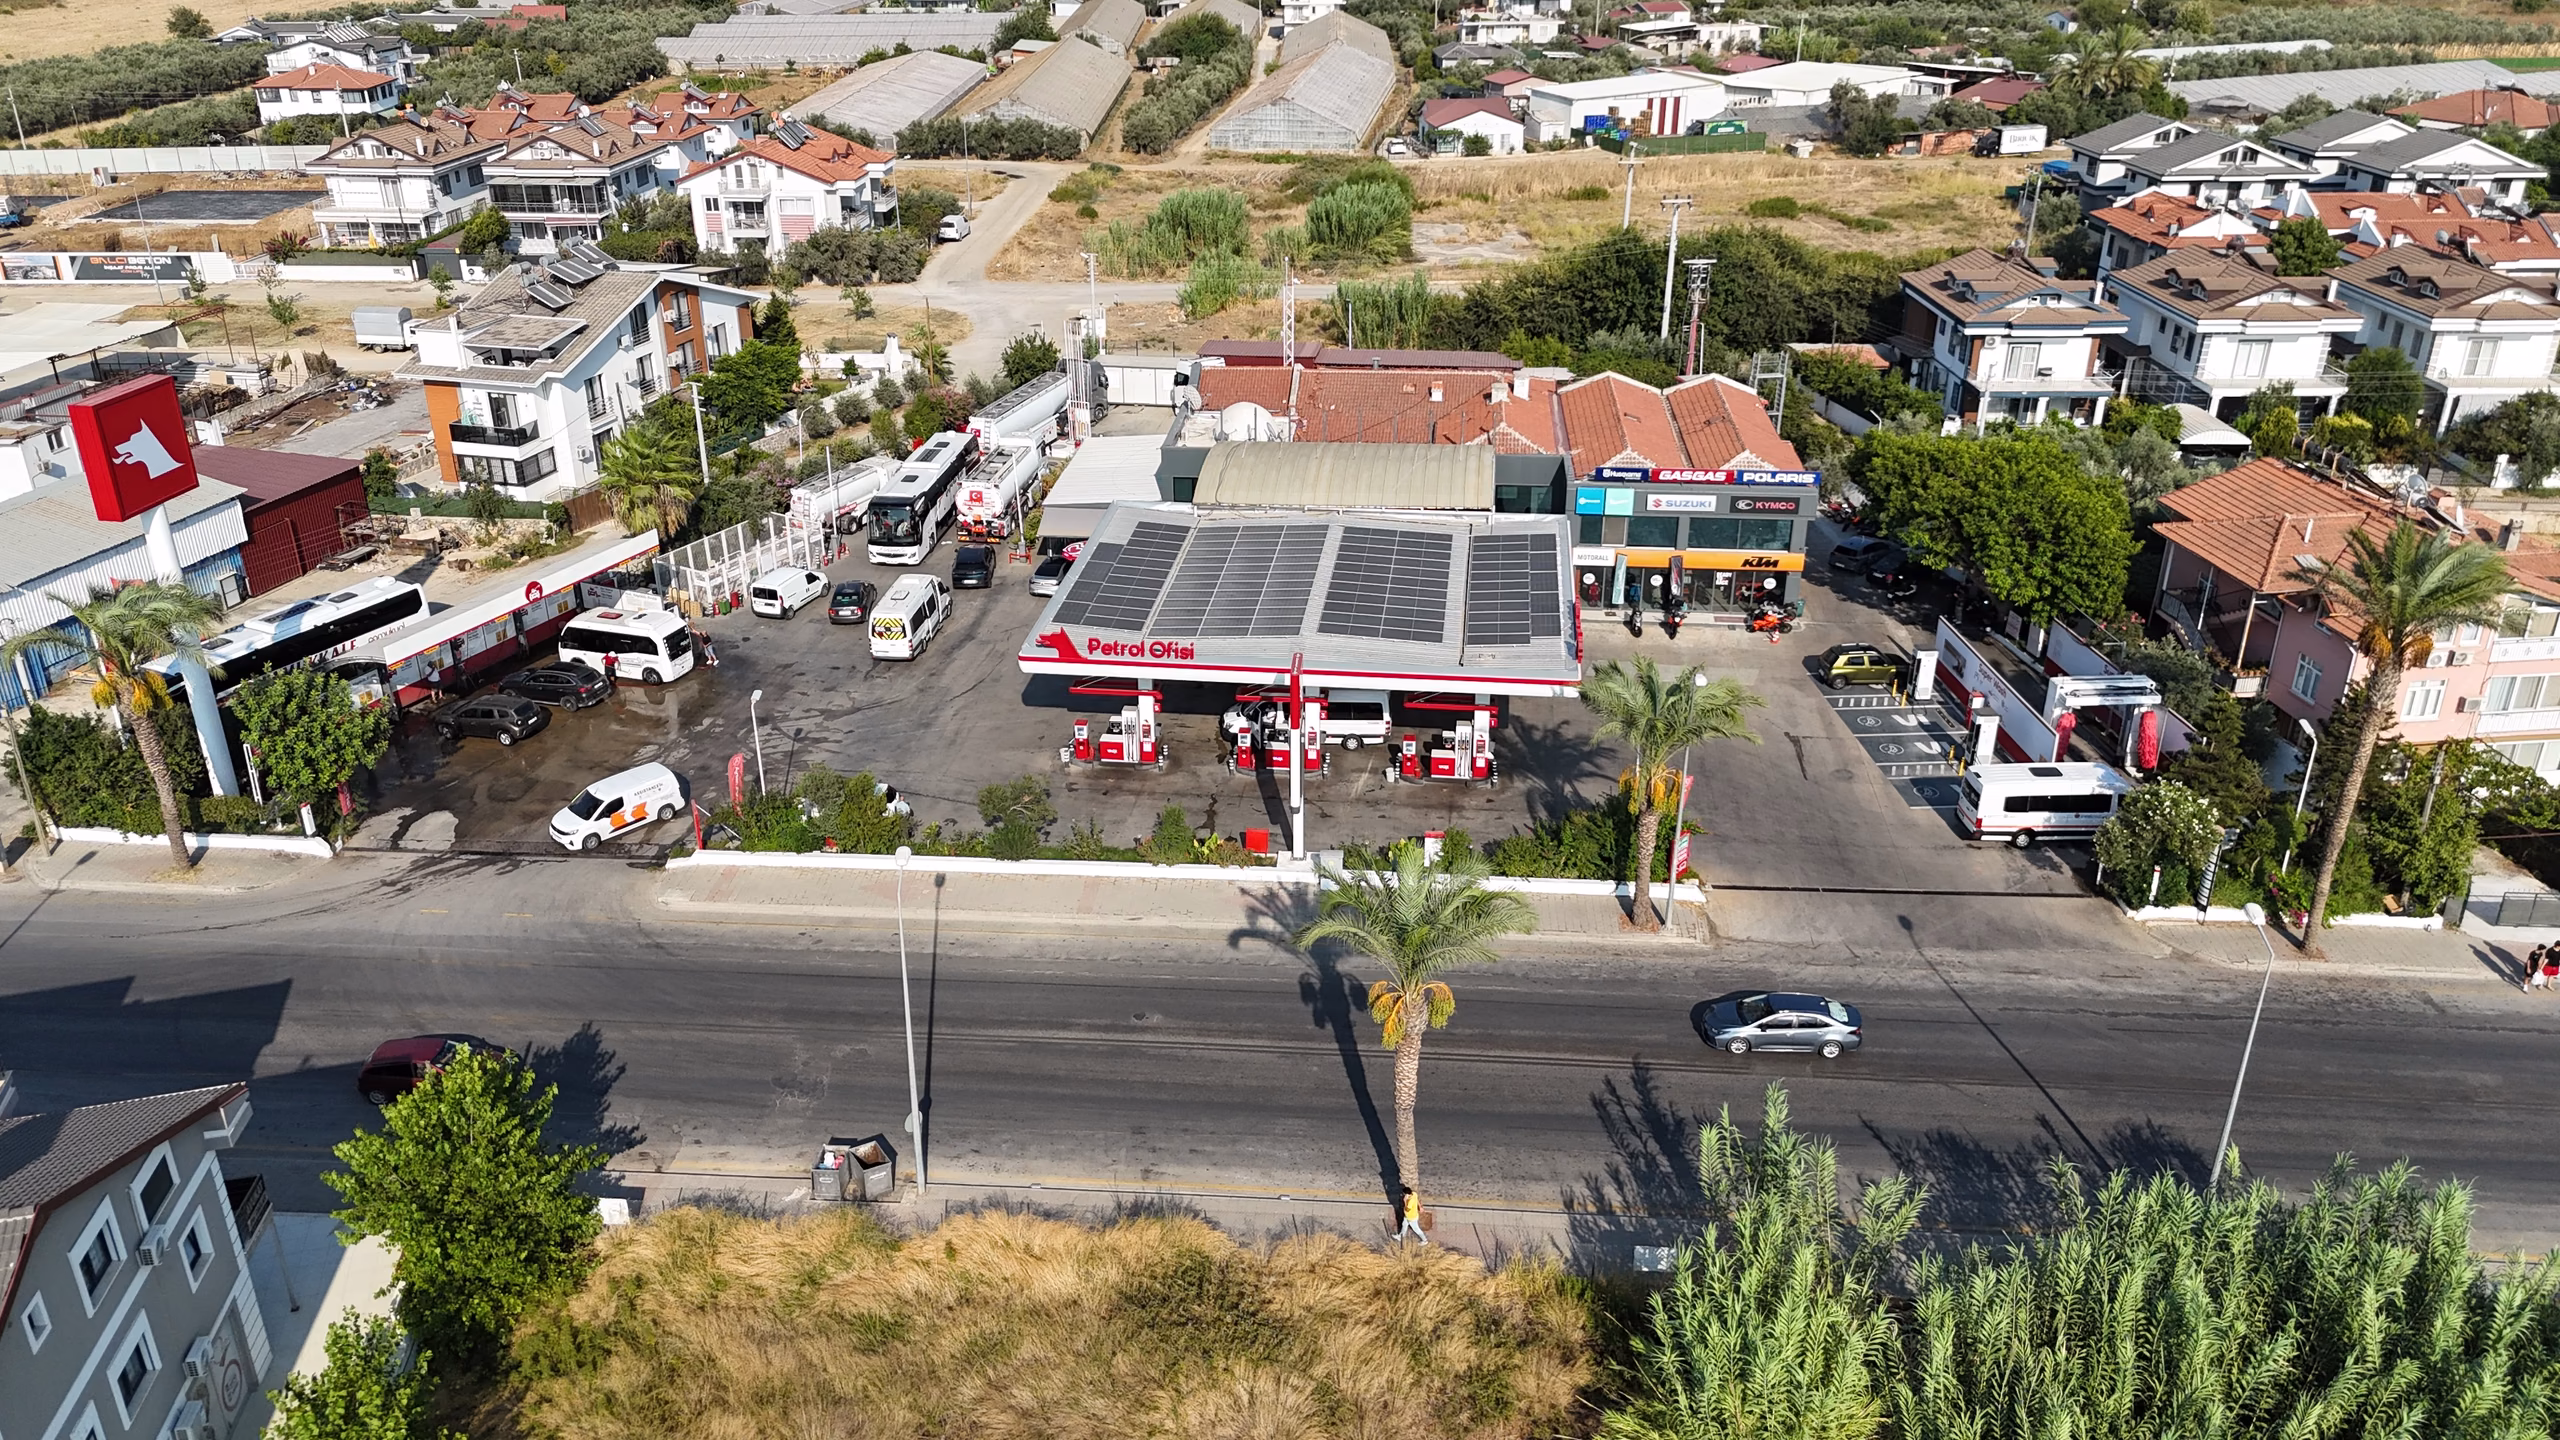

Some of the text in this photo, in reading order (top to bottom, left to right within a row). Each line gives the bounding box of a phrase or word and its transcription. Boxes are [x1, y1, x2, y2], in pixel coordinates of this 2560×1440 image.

[128, 256, 172, 264] BETON
[1659, 471, 1727, 481] GASGAS
[1743, 472, 1816, 483] POLARIS
[1665, 499, 1712, 508] SUZUKI
[1755, 501, 1796, 510] KYMCO
[1740, 556, 1780, 568] KTM
[1088, 637, 1195, 660] Petrol Ofisi
